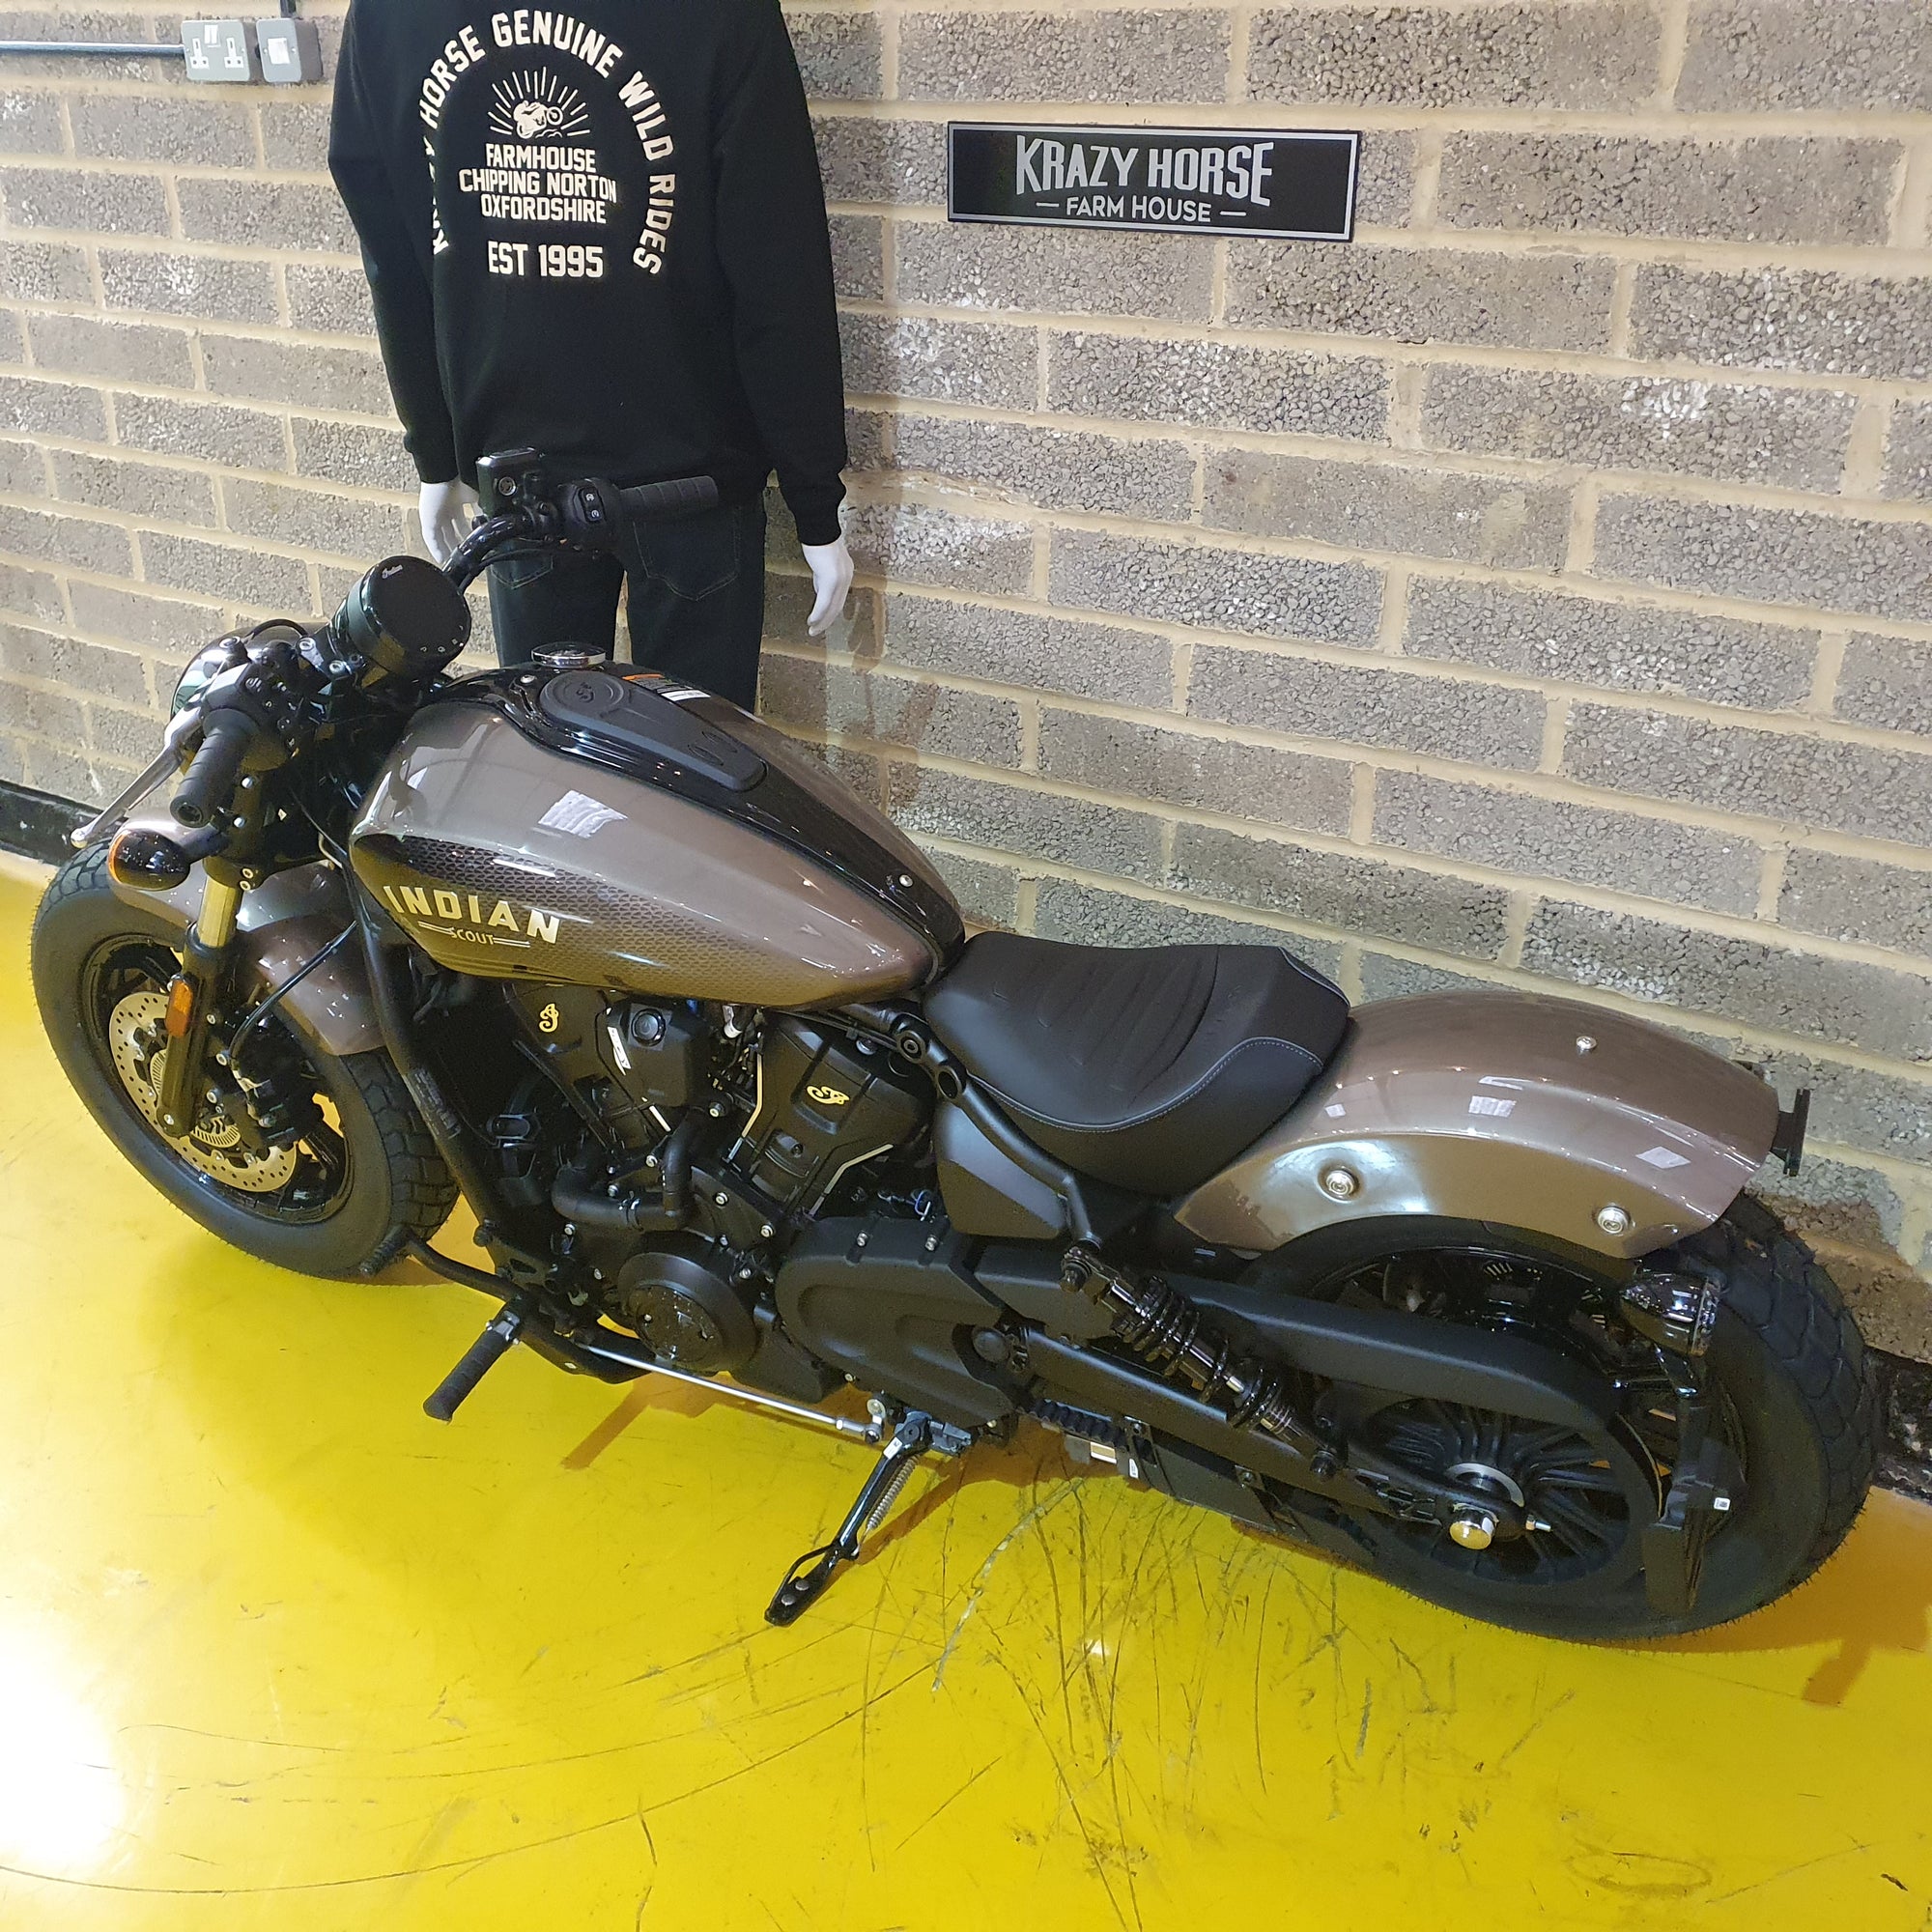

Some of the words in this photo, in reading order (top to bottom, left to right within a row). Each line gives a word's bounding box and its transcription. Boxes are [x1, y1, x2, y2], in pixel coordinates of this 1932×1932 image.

[491, 9, 624, 78] GENUINE
[418, 24, 486, 129] HORSE
[618, 71, 674, 161] WILD
[485, 143, 597, 173] FARMHOUSE
[1016, 135, 1139, 195] KRAZY
[1148, 141, 1274, 206] HORSE
[459, 168, 541, 195] CHIPPING
[547, 172, 617, 203] NORTON
[481, 194, 607, 224] OXFORDSHIRE
[1066, 195, 1124, 218] FARM
[1131, 195, 1212, 222] HOUSE
[633, 173, 676, 274] RIDES
[488, 241, 529, 276] EST
[538, 244, 605, 278] 1995
[384, 886, 560, 944] INDIAN
[450, 926, 496, 945] SCOUT
